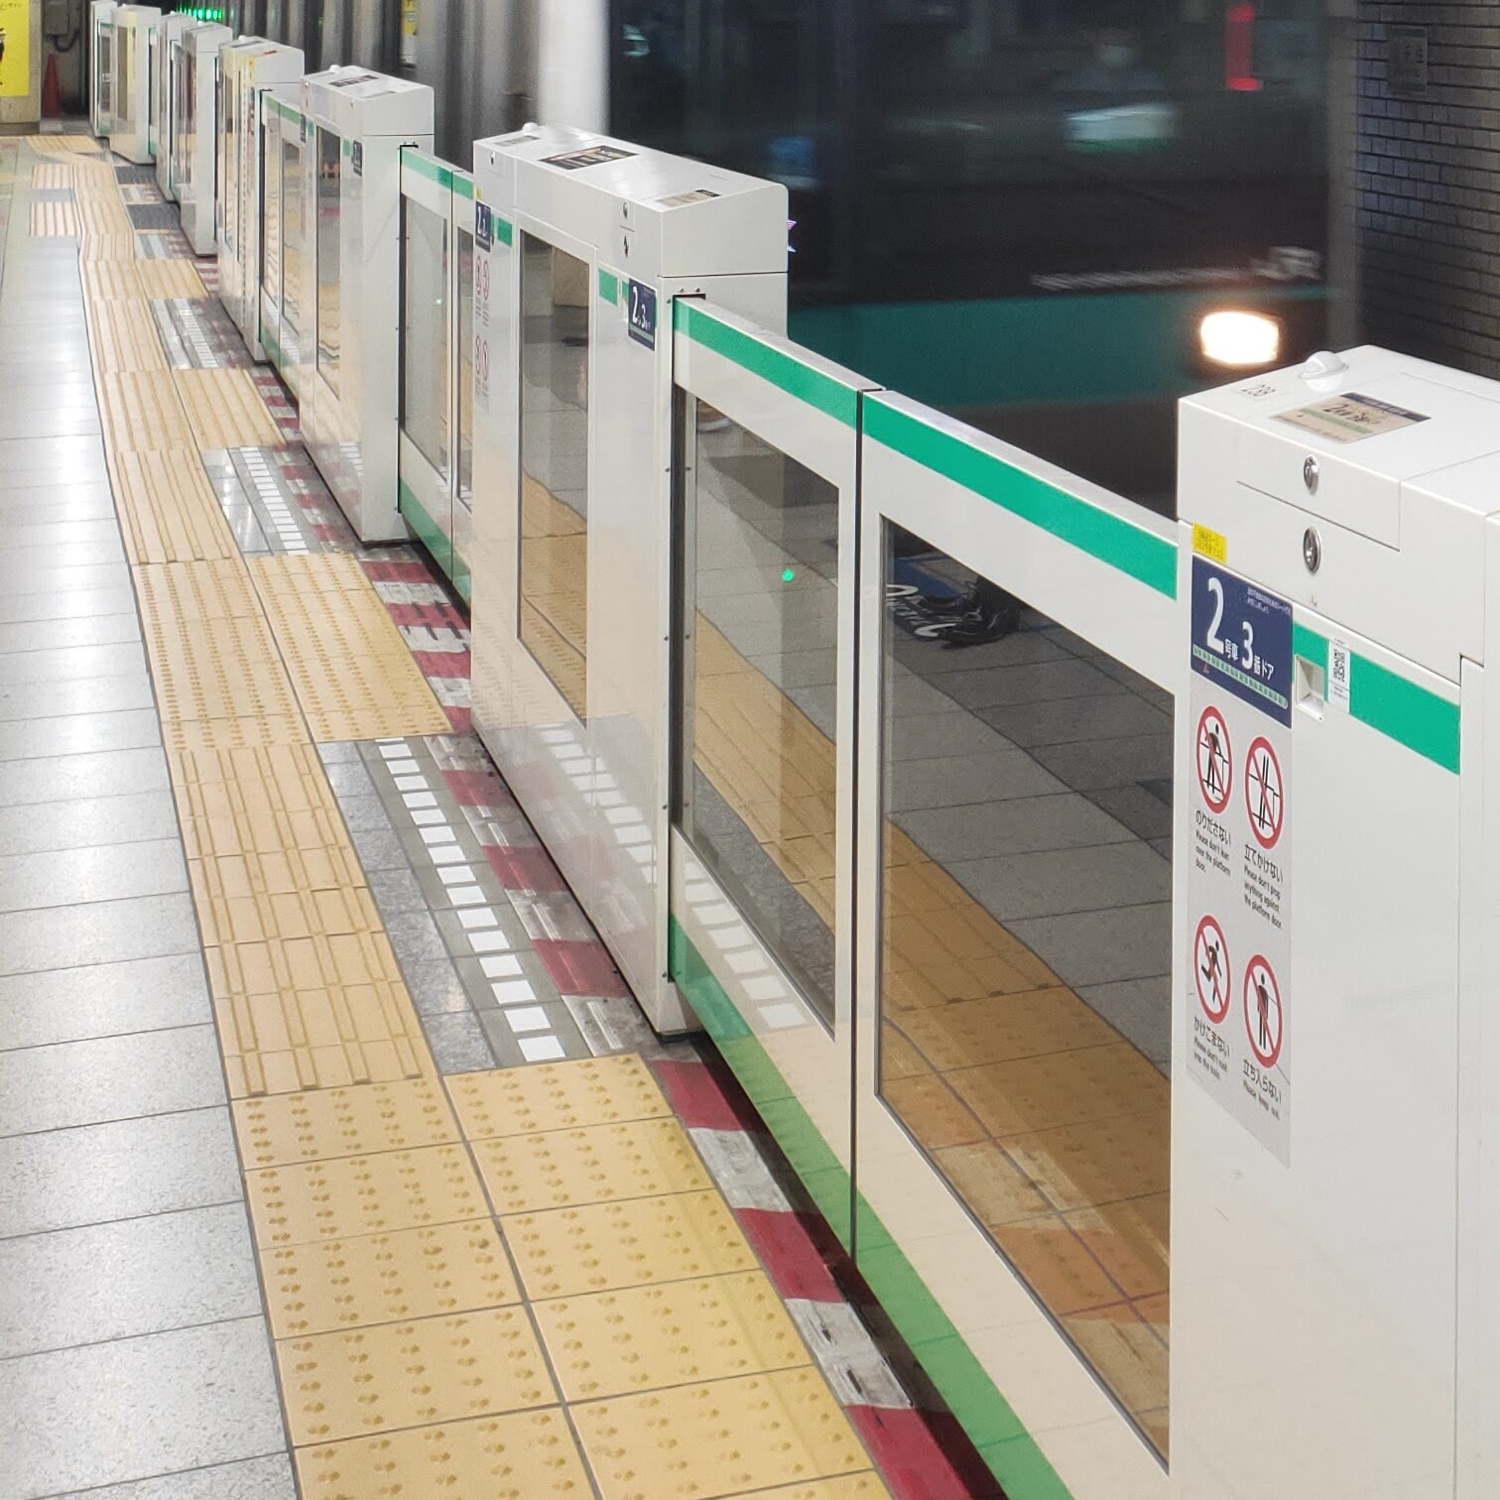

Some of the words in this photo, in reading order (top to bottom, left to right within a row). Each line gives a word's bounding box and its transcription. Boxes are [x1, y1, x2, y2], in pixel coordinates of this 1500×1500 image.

[1244, 844, 1283, 884] 立てかけない
[1243, 1059, 1282, 1104] 立ち入らない
